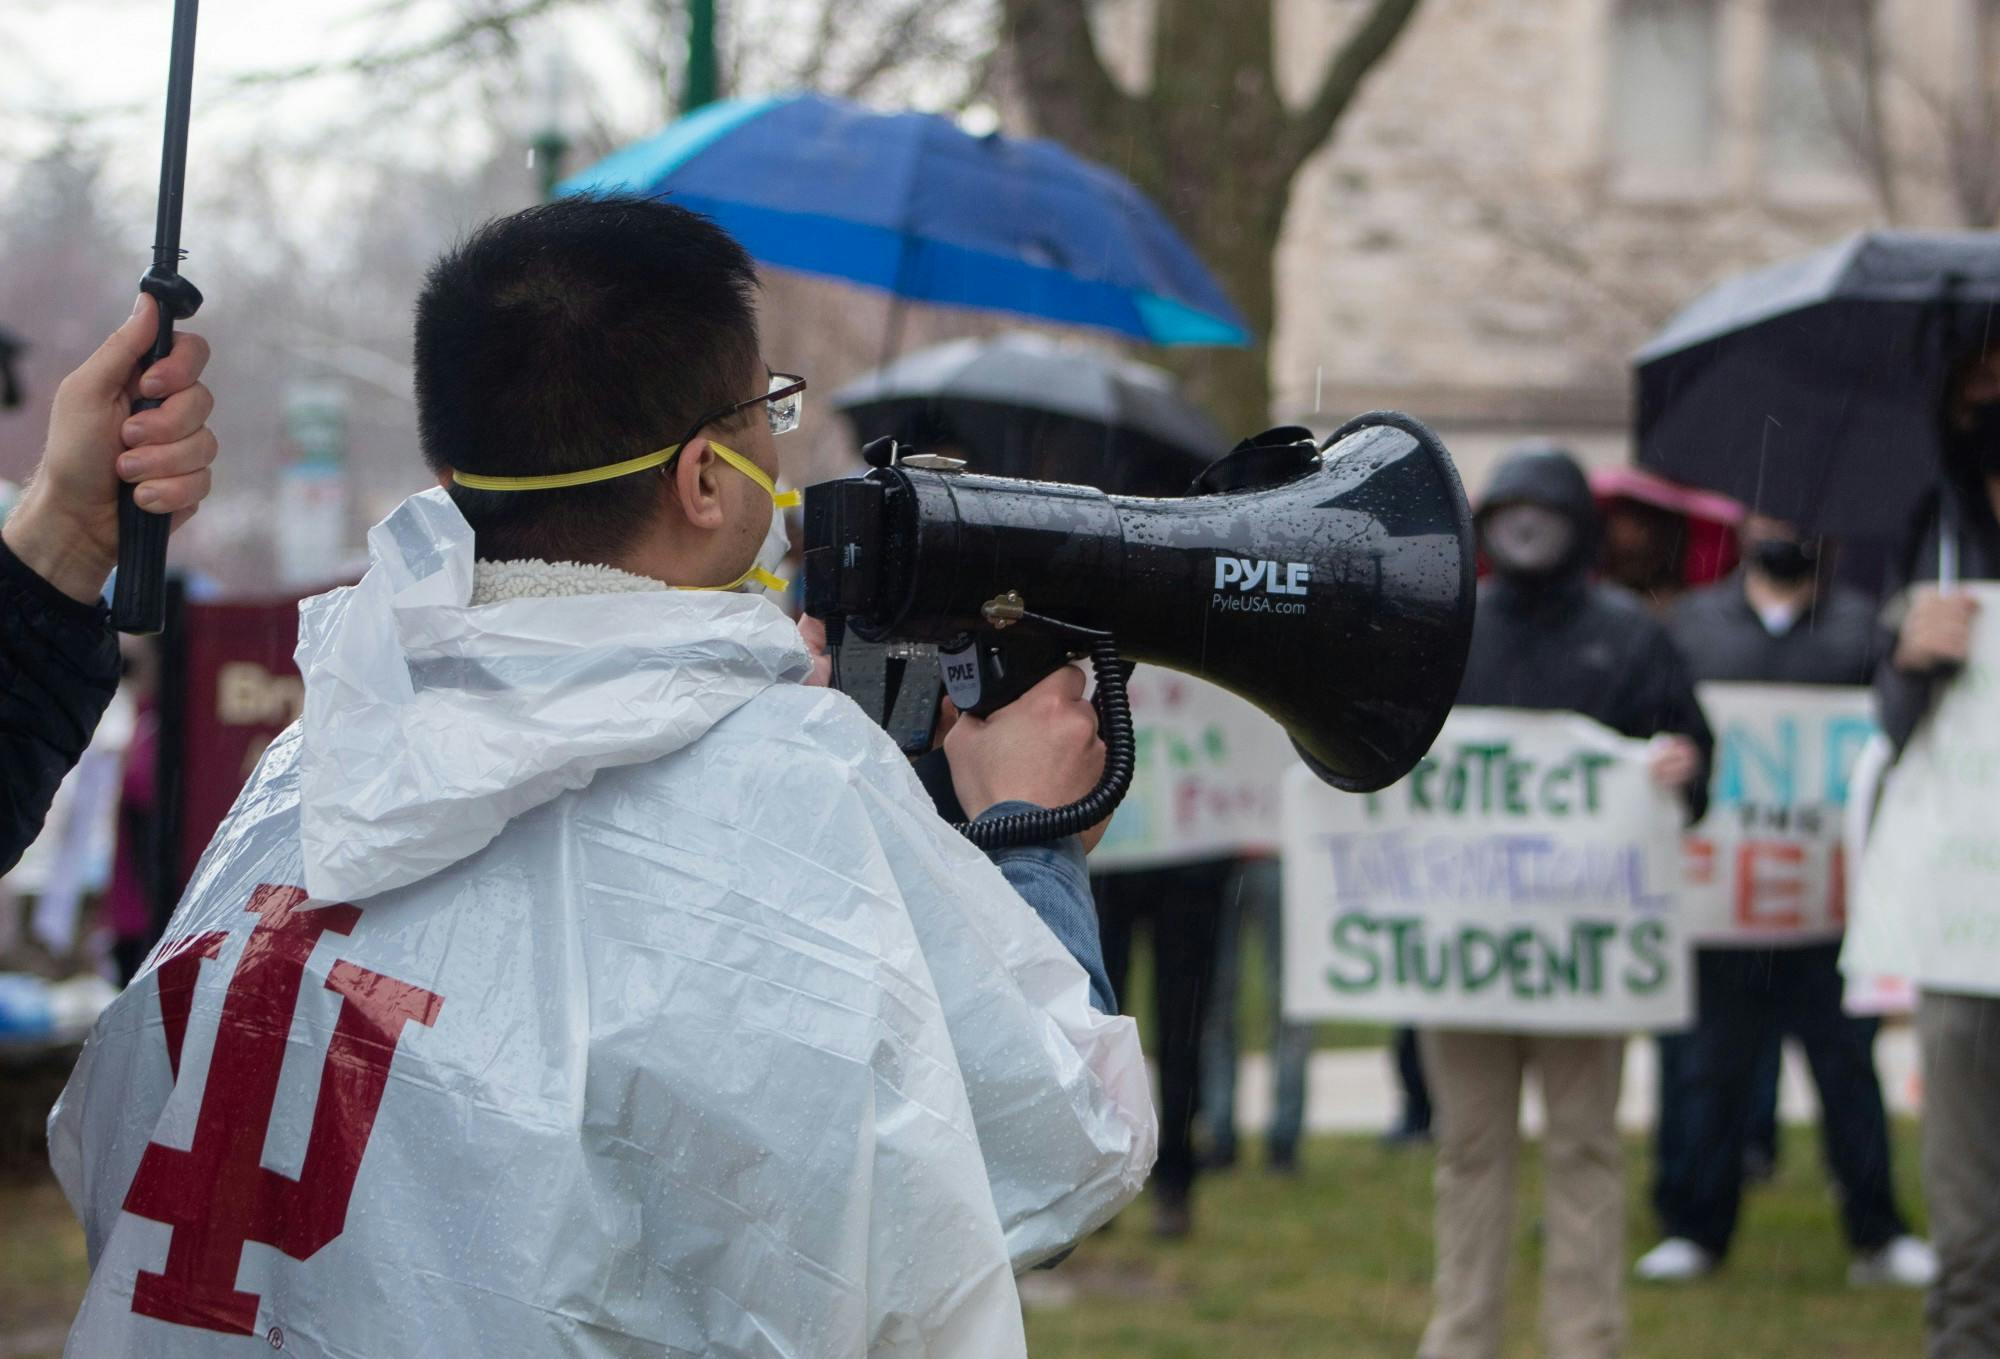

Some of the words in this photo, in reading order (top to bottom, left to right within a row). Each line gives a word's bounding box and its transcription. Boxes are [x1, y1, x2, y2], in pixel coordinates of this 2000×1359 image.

[1214, 556, 1310, 595] PYLE
[1212, 593, 1306, 614] PyleUSA.com
[947, 662, 976, 682] PYLE
[1366, 740, 1616, 817] ROTECT
[1326, 909, 1668, 998] STUDENTS
